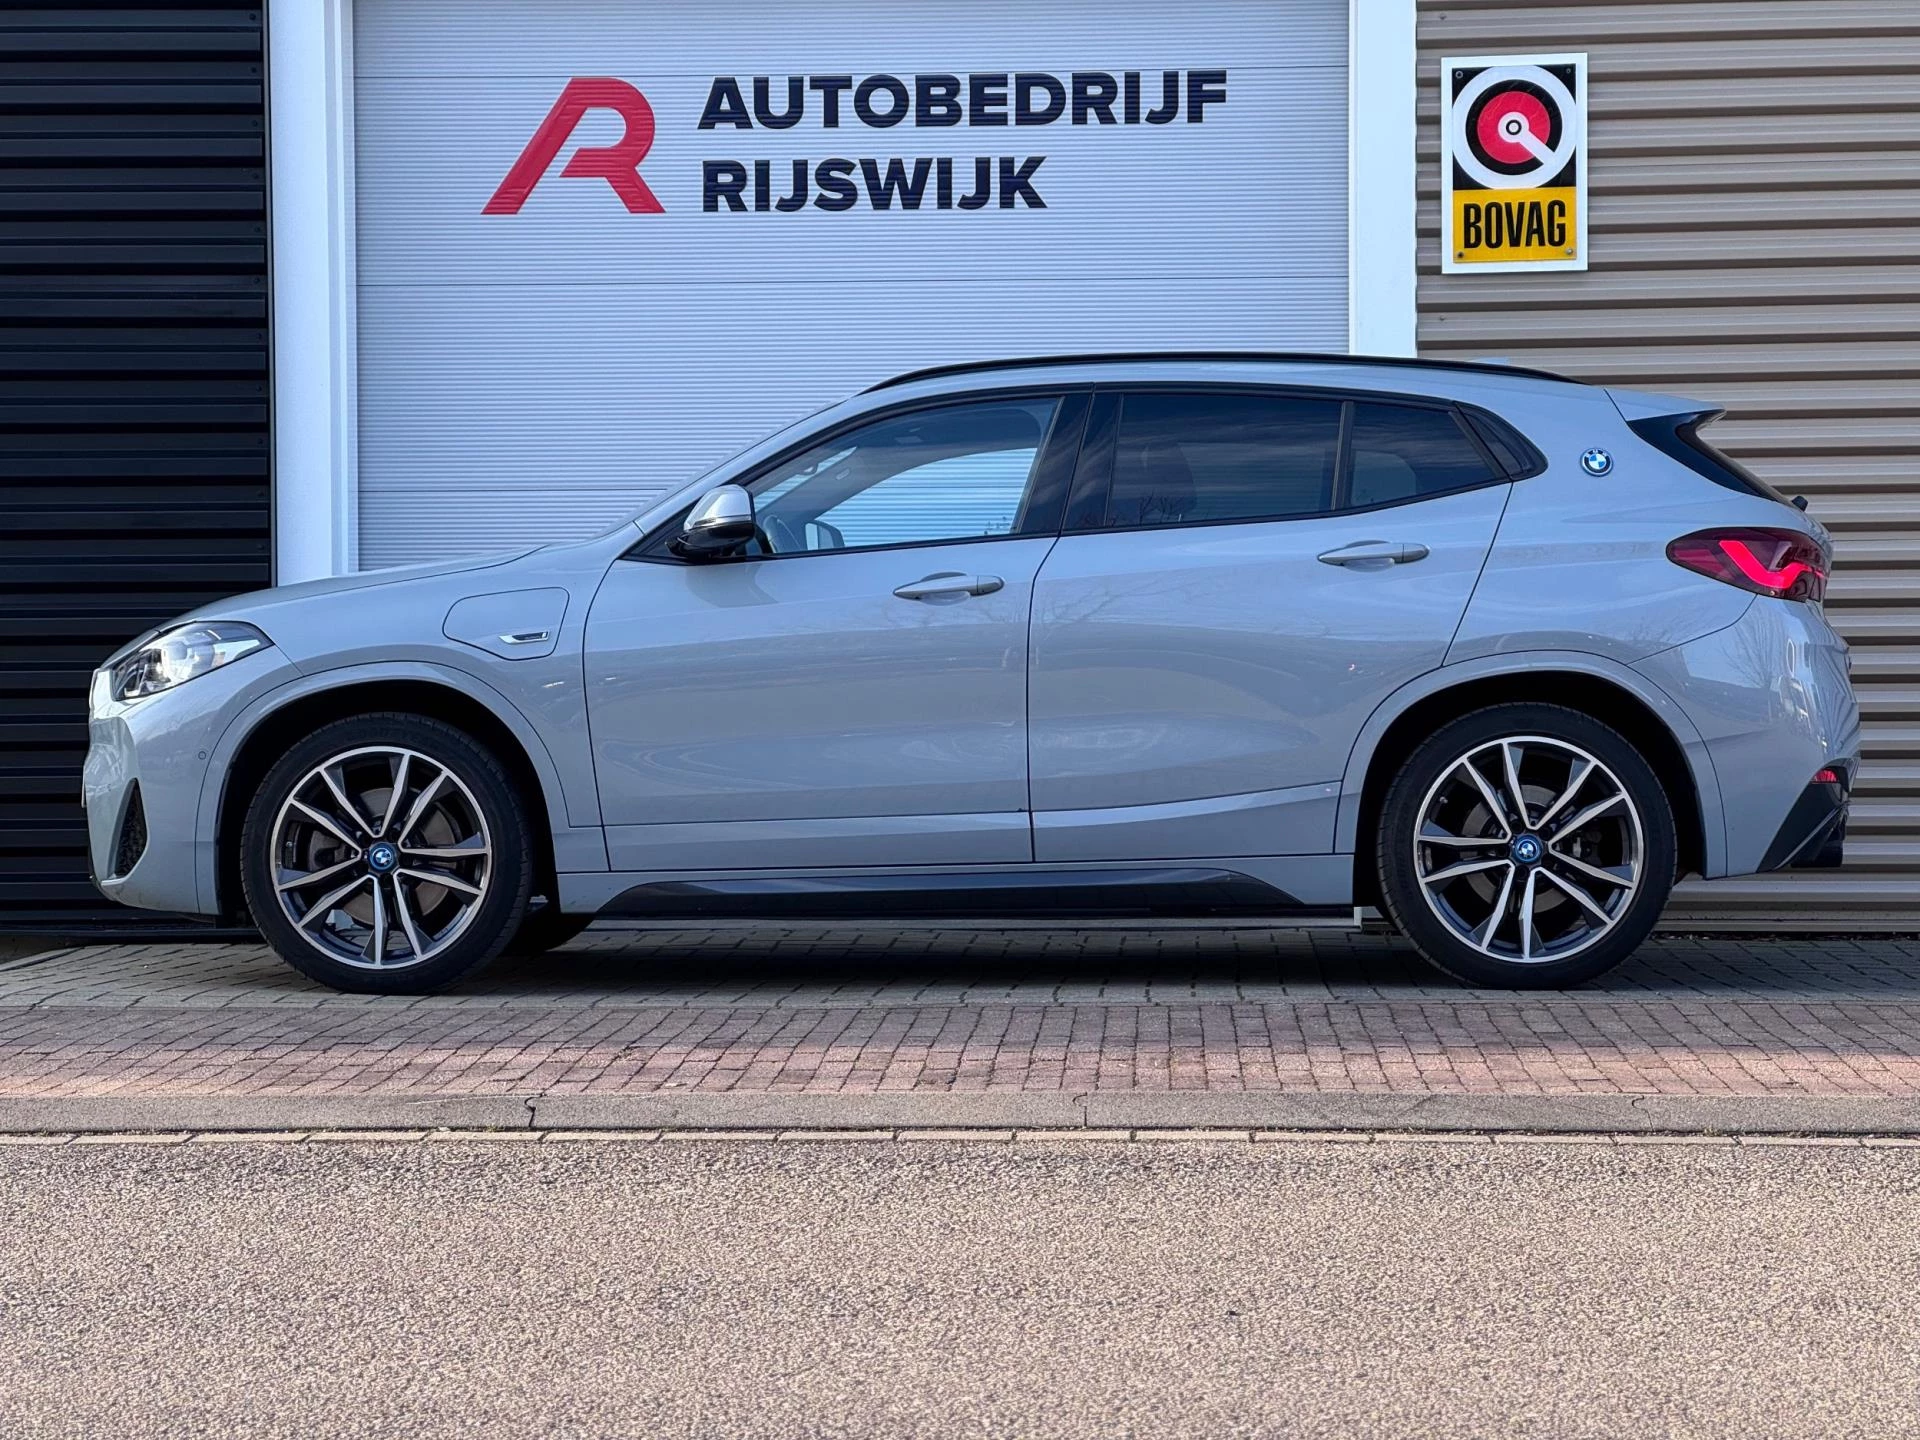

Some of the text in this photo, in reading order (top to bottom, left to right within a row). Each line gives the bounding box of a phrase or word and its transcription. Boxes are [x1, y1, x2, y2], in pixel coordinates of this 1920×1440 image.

[698, 69, 1227, 129] AUTOBEDRIJF
[703, 157, 1047, 212] RIJSWIJK
[1463, 199, 1566, 249] BOVAG
